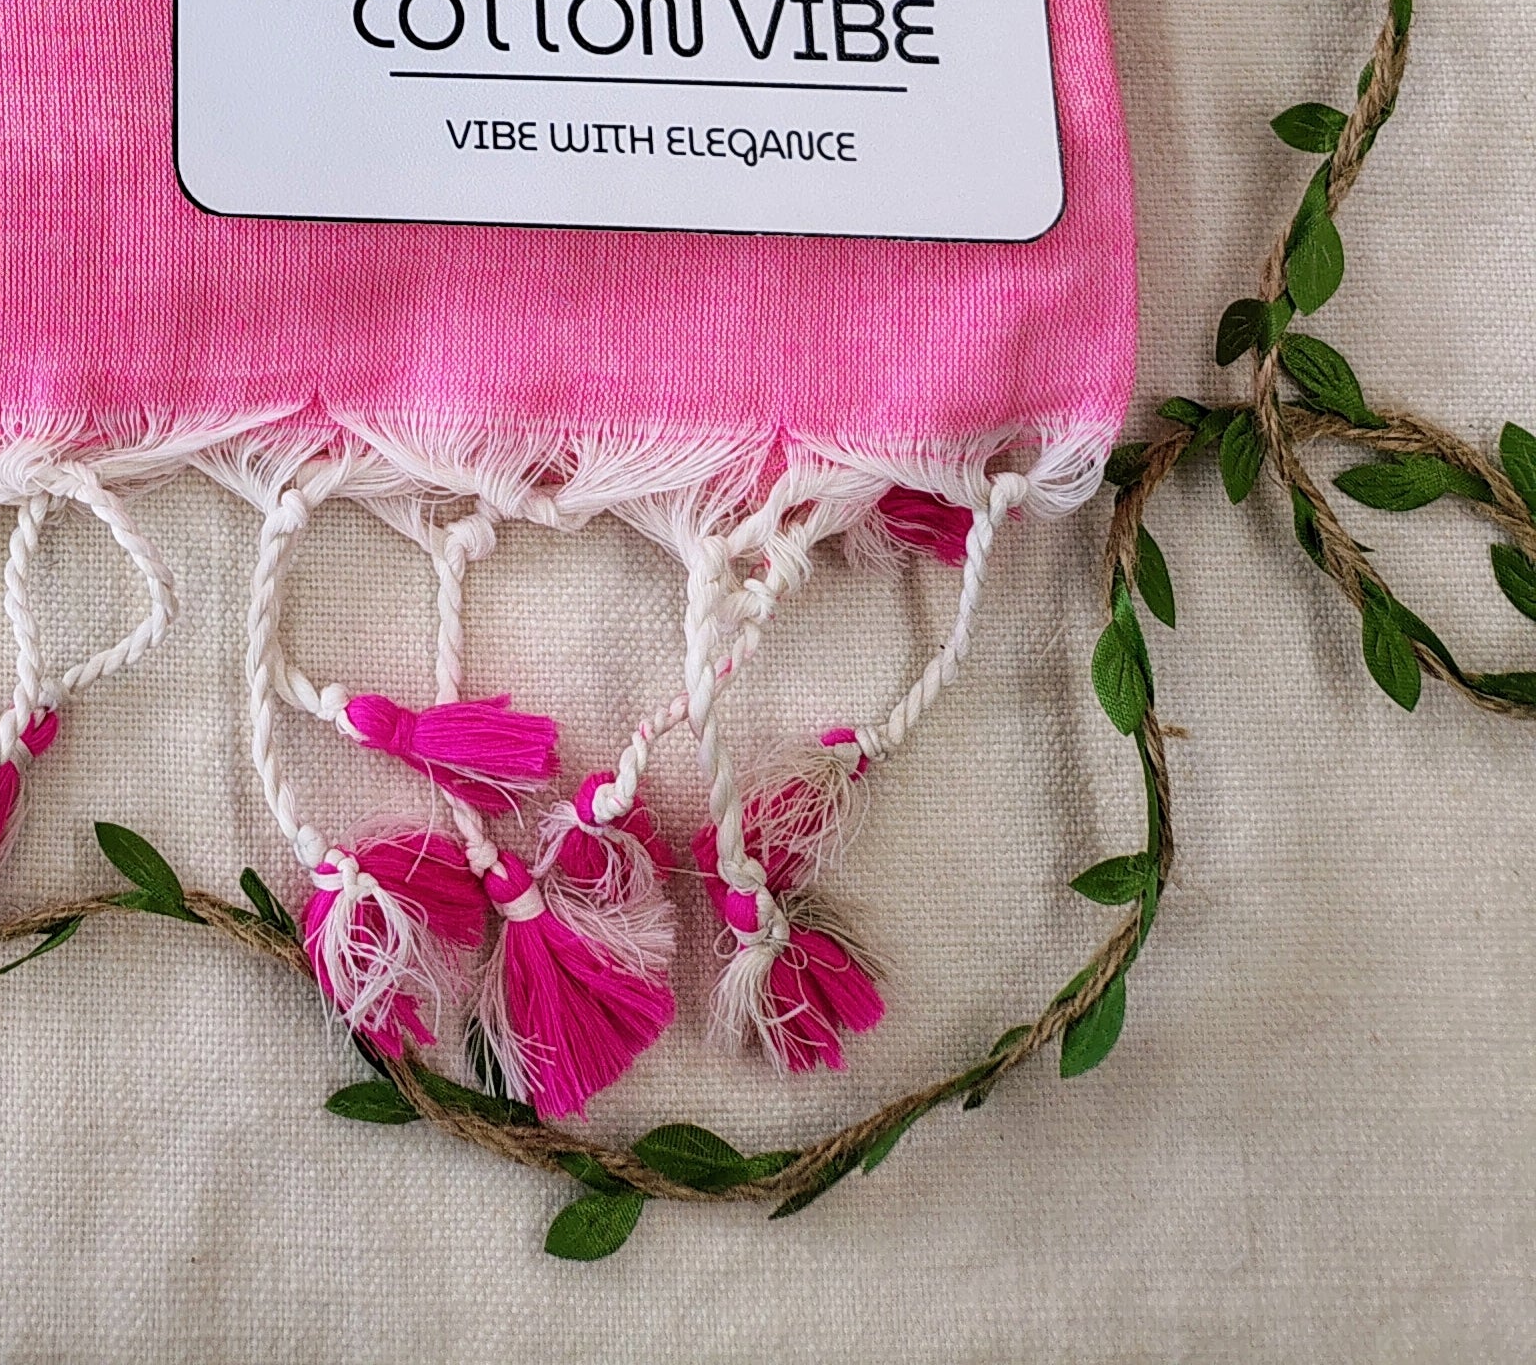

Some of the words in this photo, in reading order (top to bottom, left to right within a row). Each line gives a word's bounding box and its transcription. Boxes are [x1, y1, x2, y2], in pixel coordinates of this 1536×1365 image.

[445, 118, 539, 153] VIBE
[548, 121, 655, 156] WITH
[666, 126, 858, 168] ELEGANCE
